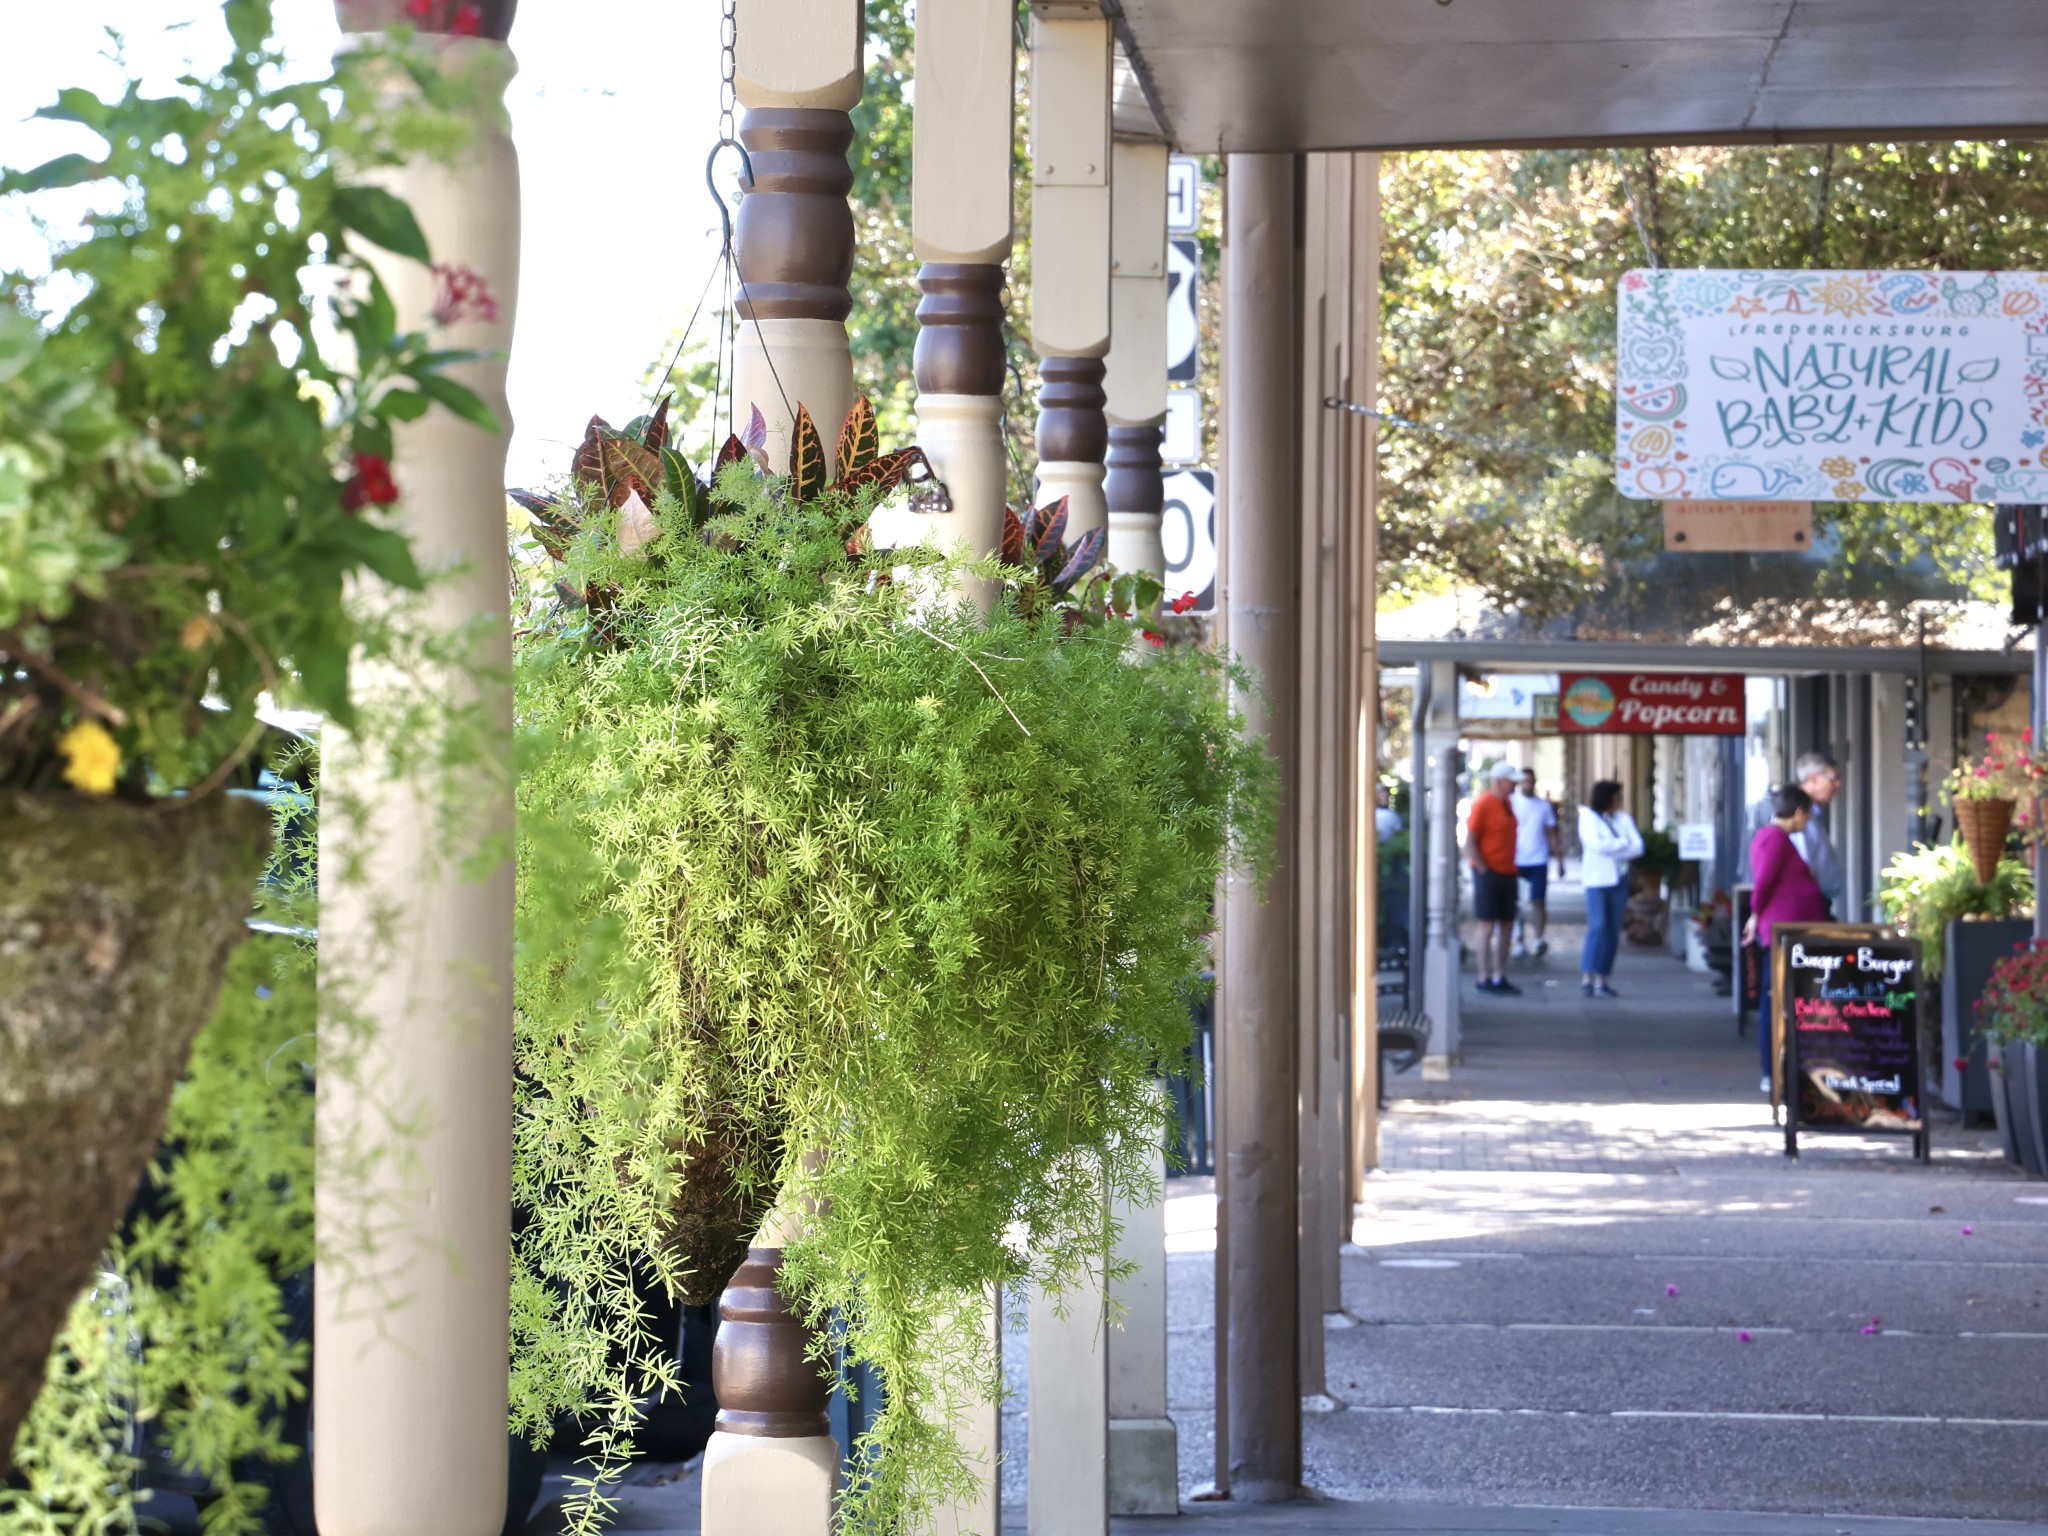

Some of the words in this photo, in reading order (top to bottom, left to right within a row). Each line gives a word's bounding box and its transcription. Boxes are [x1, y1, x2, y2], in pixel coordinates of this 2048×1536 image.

[1753, 343, 1955, 394] NATURAL
[1629, 675, 1703, 700] Candy
[1709, 677, 1727, 695] &
[1618, 698, 1737, 728] Popcorn
[1791, 943, 1843, 984] Burger
[1857, 946, 1914, 984] Burger
